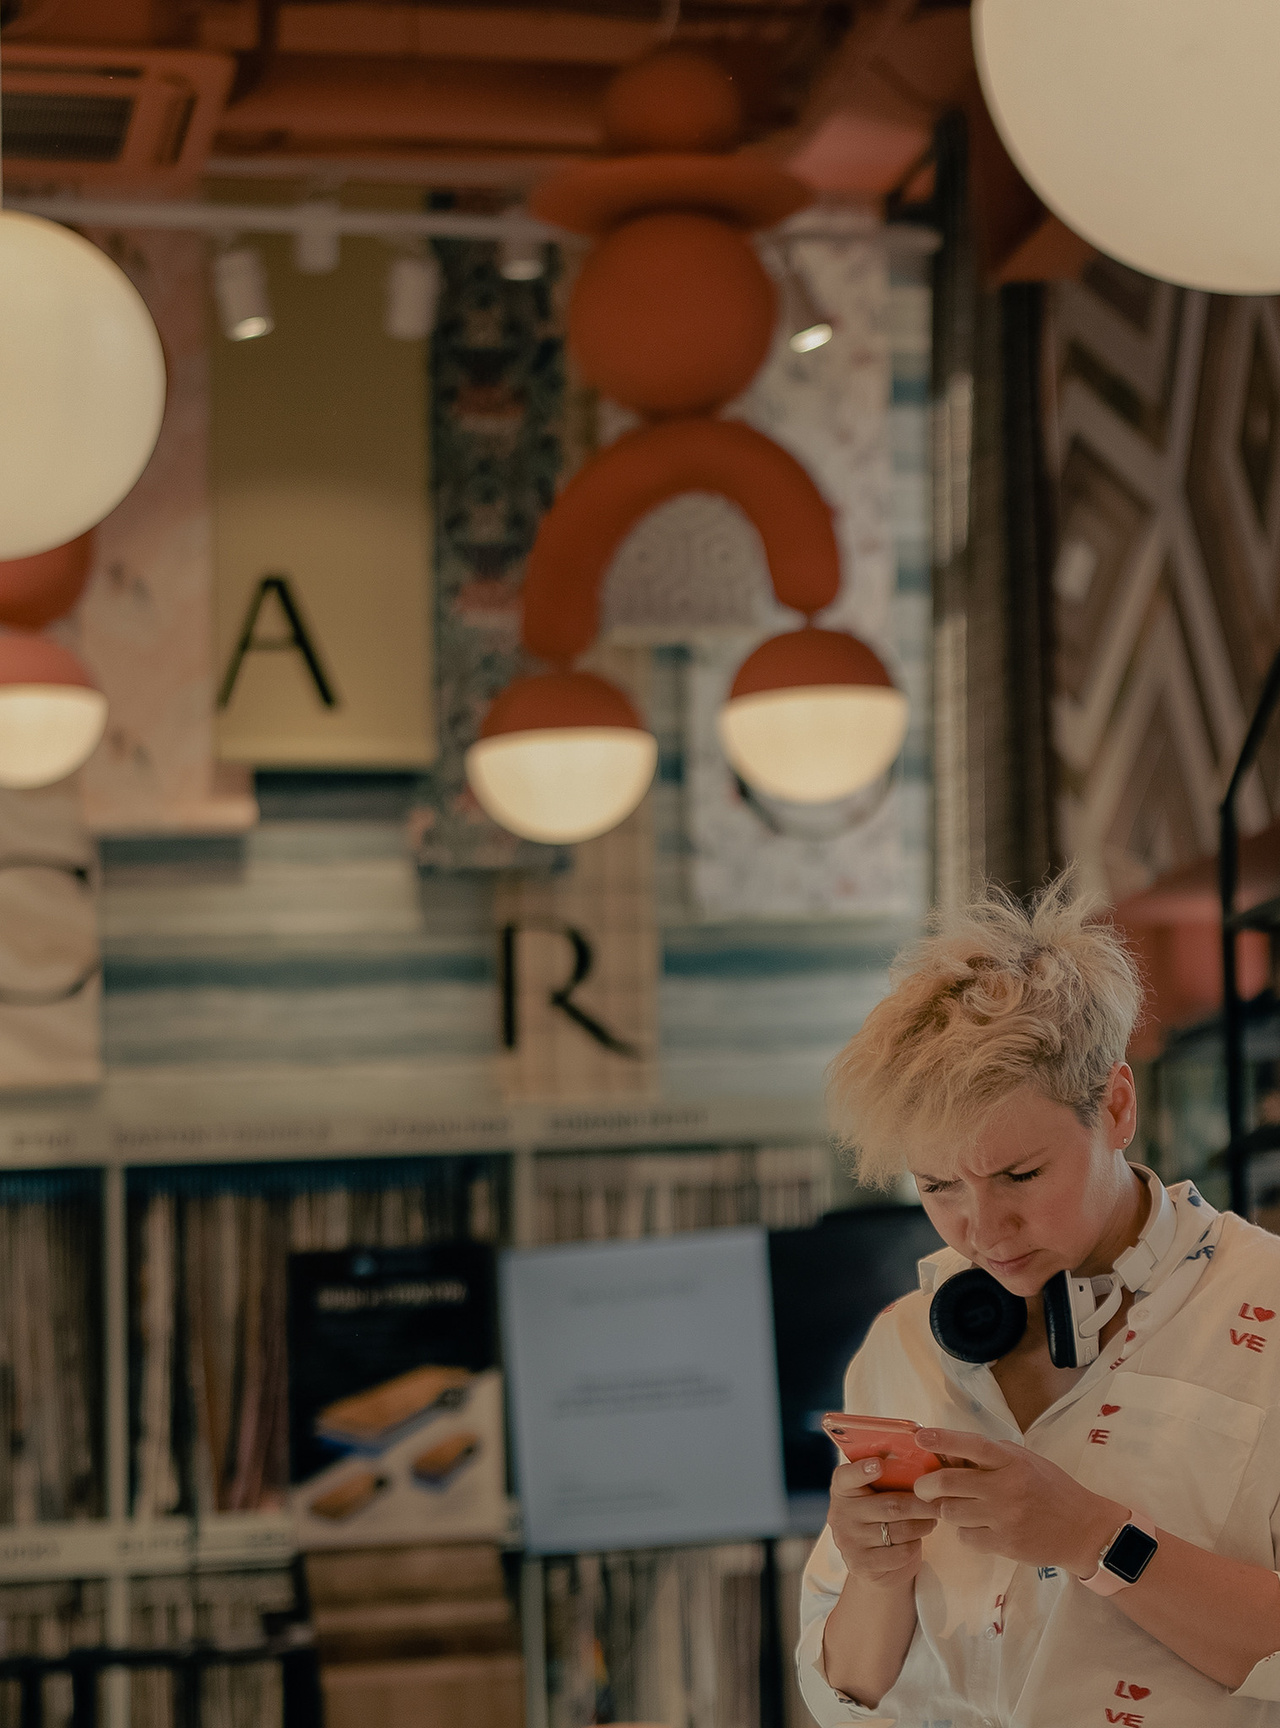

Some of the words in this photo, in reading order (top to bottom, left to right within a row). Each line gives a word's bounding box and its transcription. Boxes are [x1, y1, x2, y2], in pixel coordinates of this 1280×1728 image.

[216, 574, 337, 707] A
[503, 914, 641, 1060] R
[1229, 1328, 1267, 1353] VE
